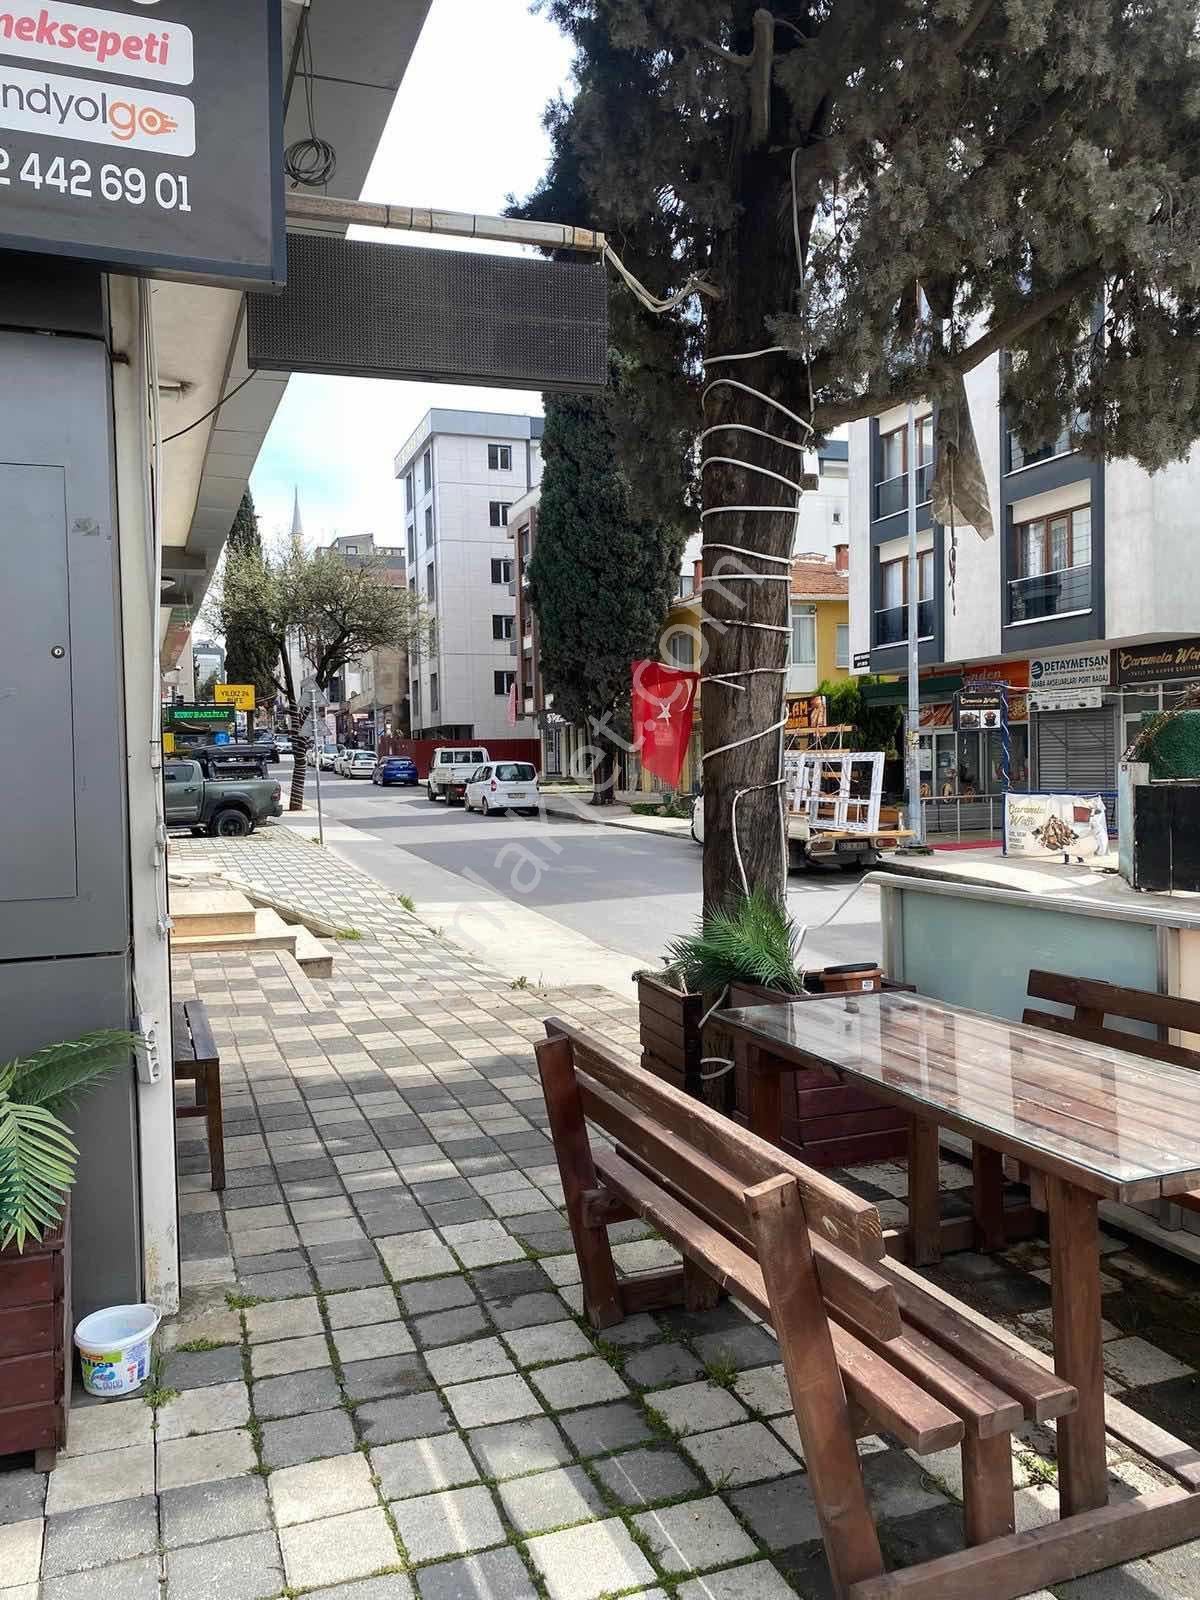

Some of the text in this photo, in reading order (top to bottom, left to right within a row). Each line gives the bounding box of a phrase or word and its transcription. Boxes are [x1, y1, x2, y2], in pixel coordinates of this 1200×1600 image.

[19, 152, 92, 197] 442
[100, 163, 146, 205] 69
[155, 172, 192, 212] 01
[1044, 655, 1109, 672] DETAYMETSAN
